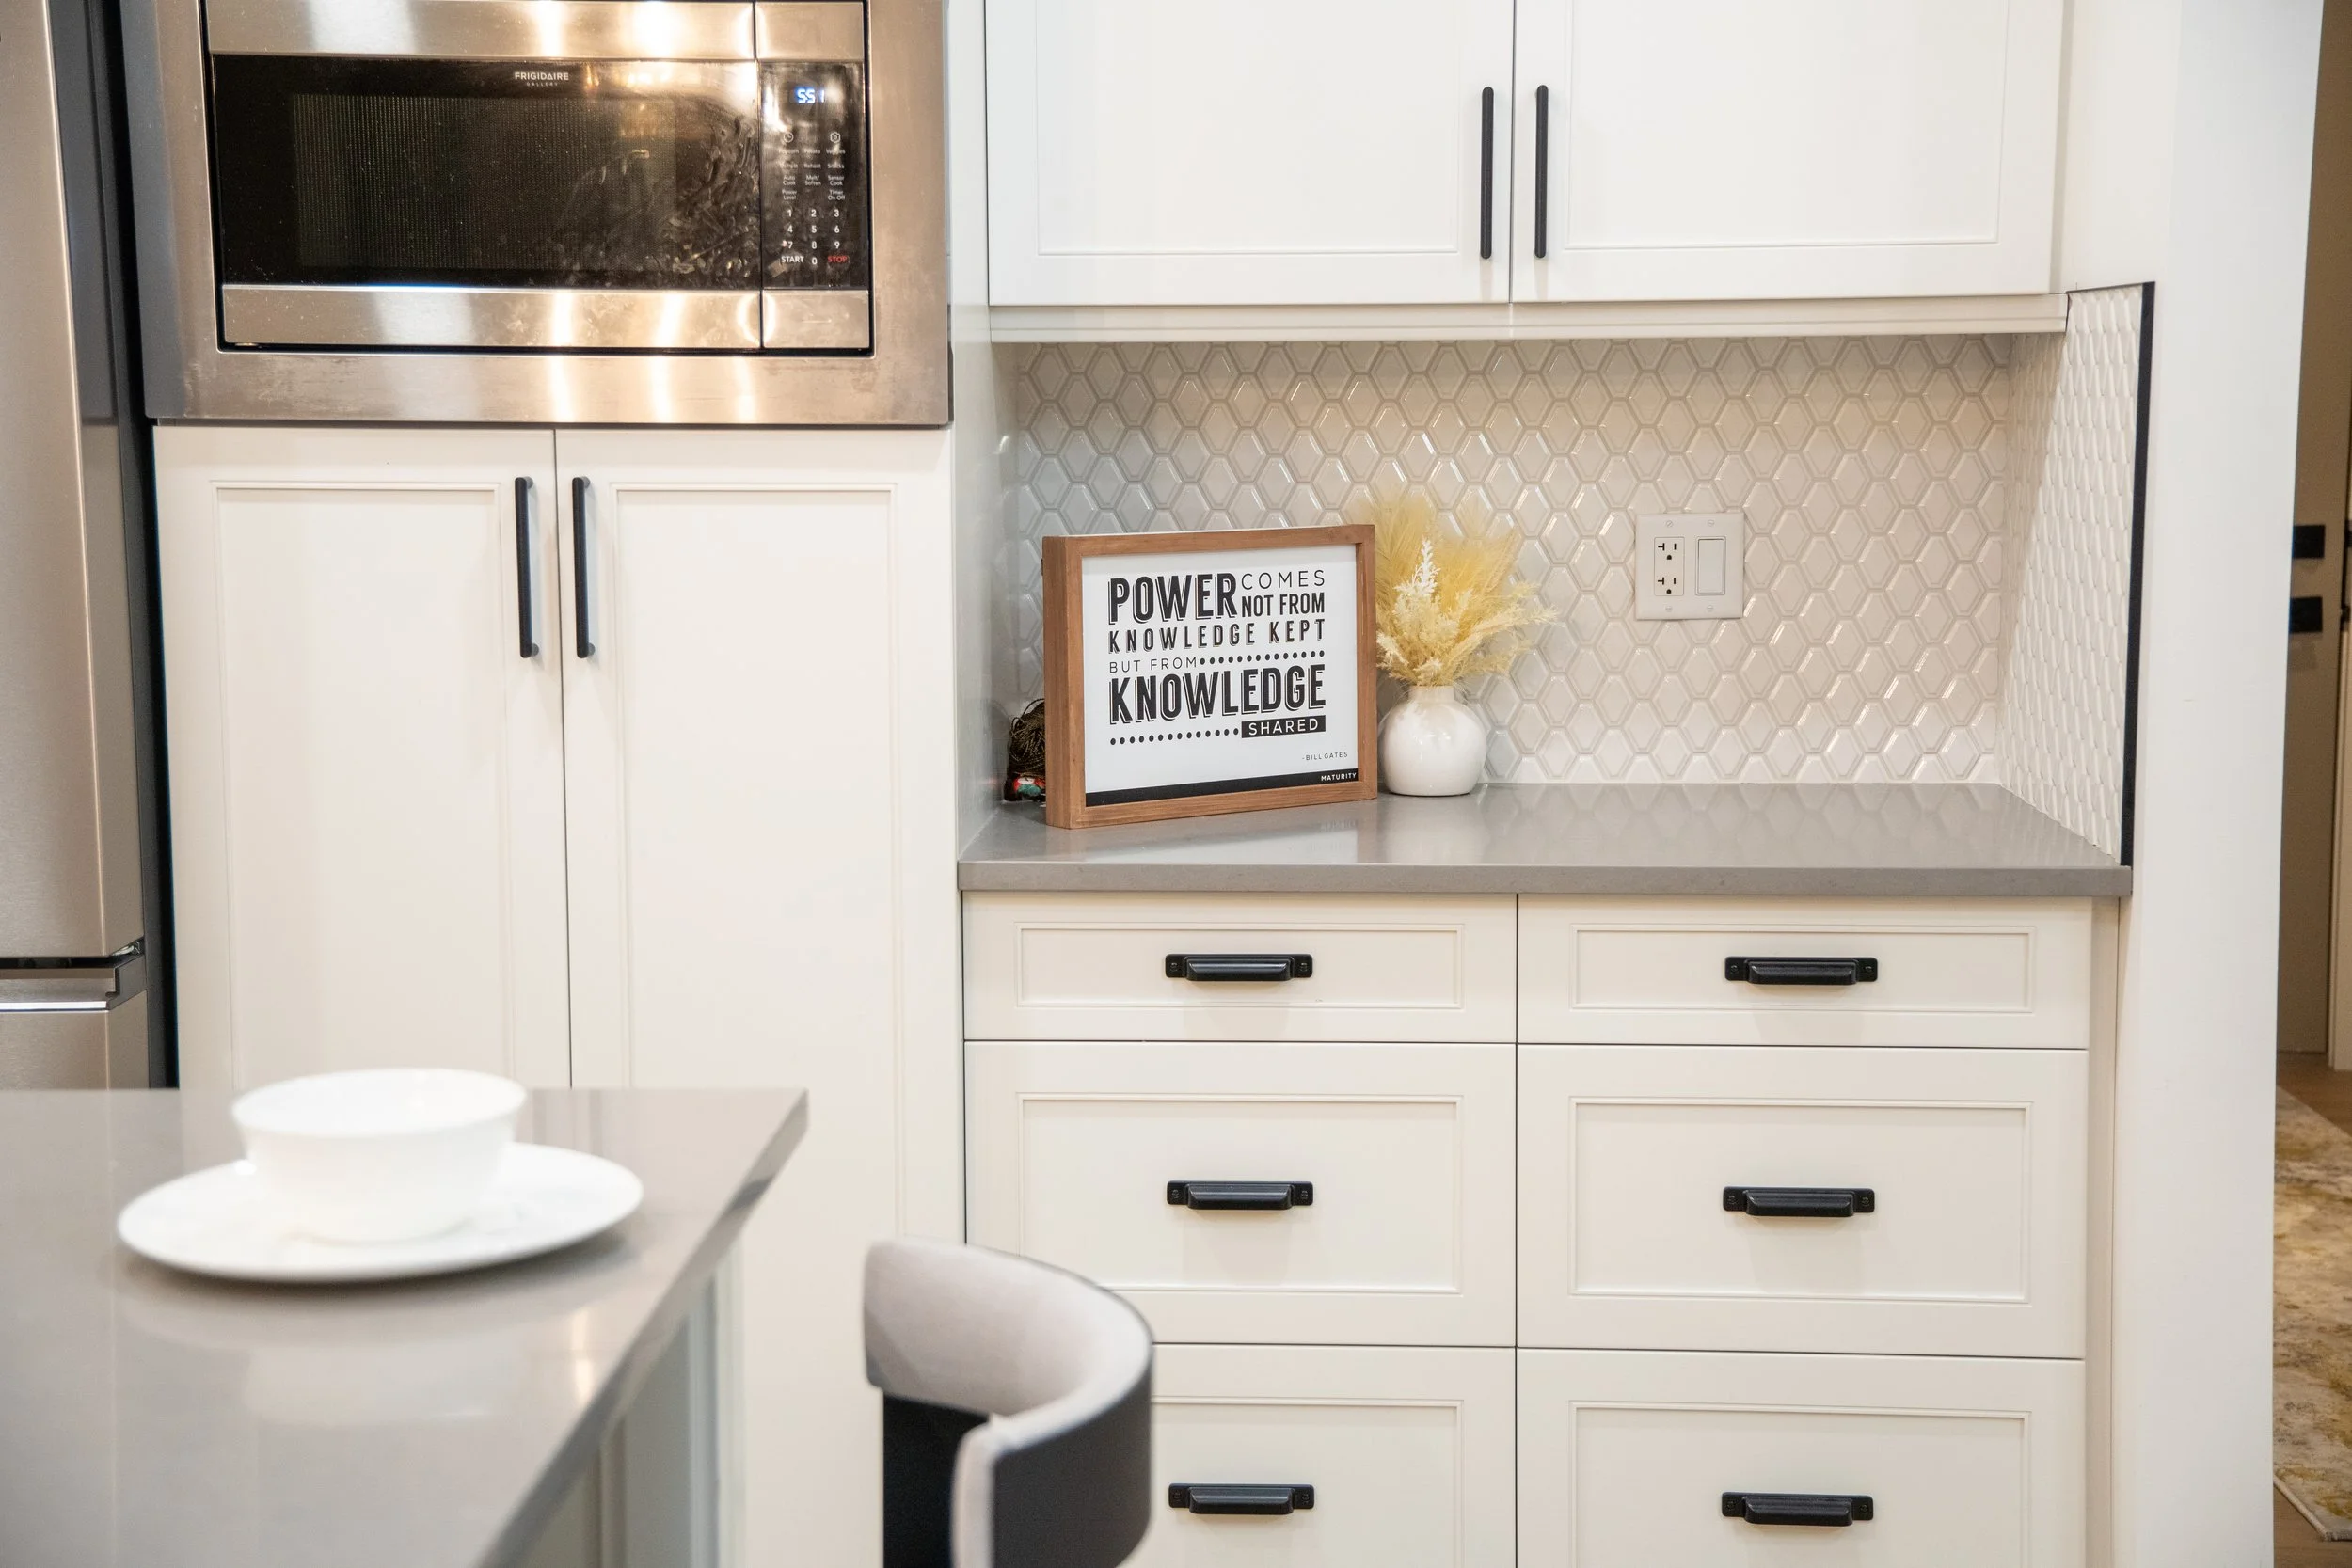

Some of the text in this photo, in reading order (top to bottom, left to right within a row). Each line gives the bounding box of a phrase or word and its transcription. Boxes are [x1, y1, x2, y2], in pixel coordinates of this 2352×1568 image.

[515, 71, 569, 80] FRIGIDAIRE
[787, 209, 792, 217] 1
[811, 209, 817, 217] 2
[834, 209, 839, 217] 3
[787, 225, 793, 233] 4
[811, 225, 817, 233] 5
[834, 225, 840, 233] 6
[787, 241, 793, 249] 7
[811, 241, 817, 249] 8
[834, 241, 840, 249] 9
[828, 255, 847, 263] STOP
[1108, 569, 1325, 625] POWER COMES
[1241, 592, 1325, 617] NOT FROM
[1108, 618, 1325, 654] KNOWLEDGE KEPT
[1109, 657, 1197, 673] BUT FROM
[1108, 663, 1326, 725] KNOWLEDGE
[1248, 718, 1319, 736] SHARED
[1321, 772, 1357, 781] MATURITY
